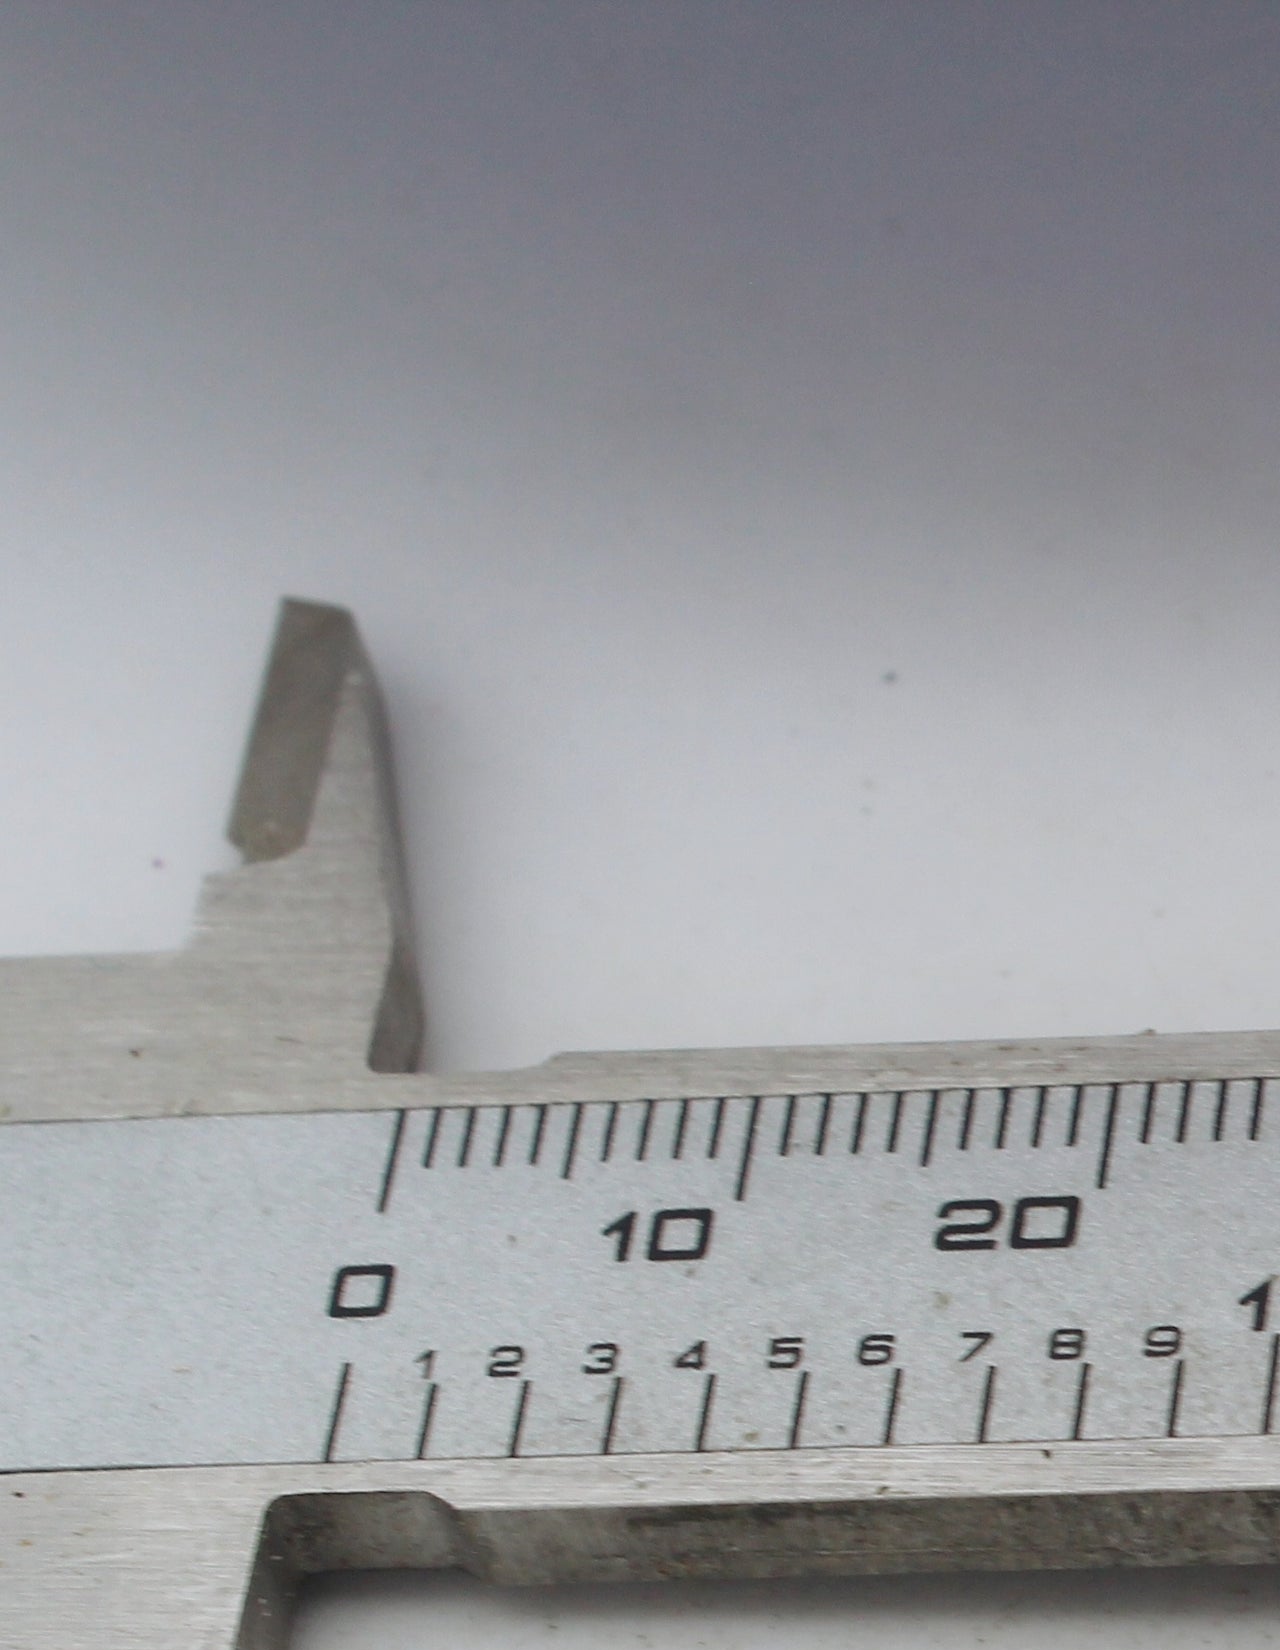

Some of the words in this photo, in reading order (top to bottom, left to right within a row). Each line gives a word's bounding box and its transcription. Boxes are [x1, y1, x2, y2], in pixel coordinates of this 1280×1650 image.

[603, 1208, 714, 1262] 10
[935, 1196, 1080, 1251] 20
[328, 1264, 395, 1318] 0
[1238, 1274, 1277, 1332] 1
[416, 1350, 437, 1379] 1
[488, 1346, 525, 1377] 2
[584, 1343, 619, 1374] 3
[674, 1341, 706, 1370] 4
[769, 1338, 802, 1368] 5
[858, 1335, 894, 1366] 6
[959, 1332, 994, 1362] 7
[1049, 1329, 1084, 1360] 8
[1144, 1326, 1181, 1357] 9
